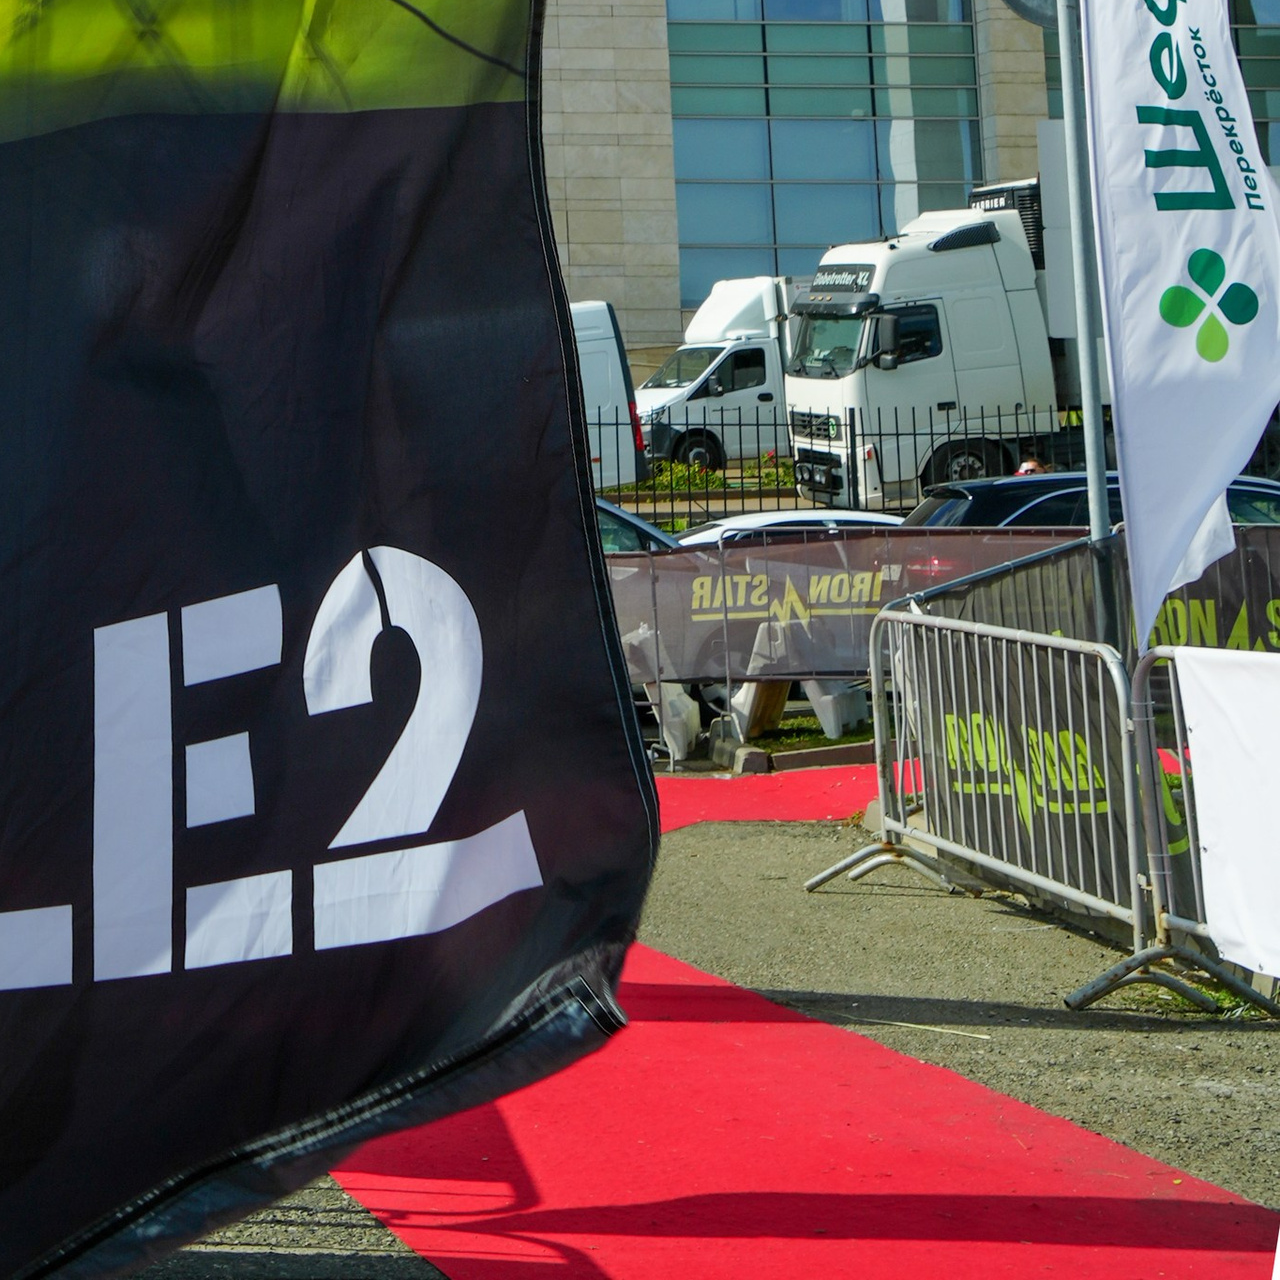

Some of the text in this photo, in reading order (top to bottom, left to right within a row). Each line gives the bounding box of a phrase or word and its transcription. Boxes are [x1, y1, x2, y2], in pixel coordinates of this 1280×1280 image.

[1188, 26, 1265, 211] Перекрёсток
[813, 271, 870, 286] Globetrotter XL
